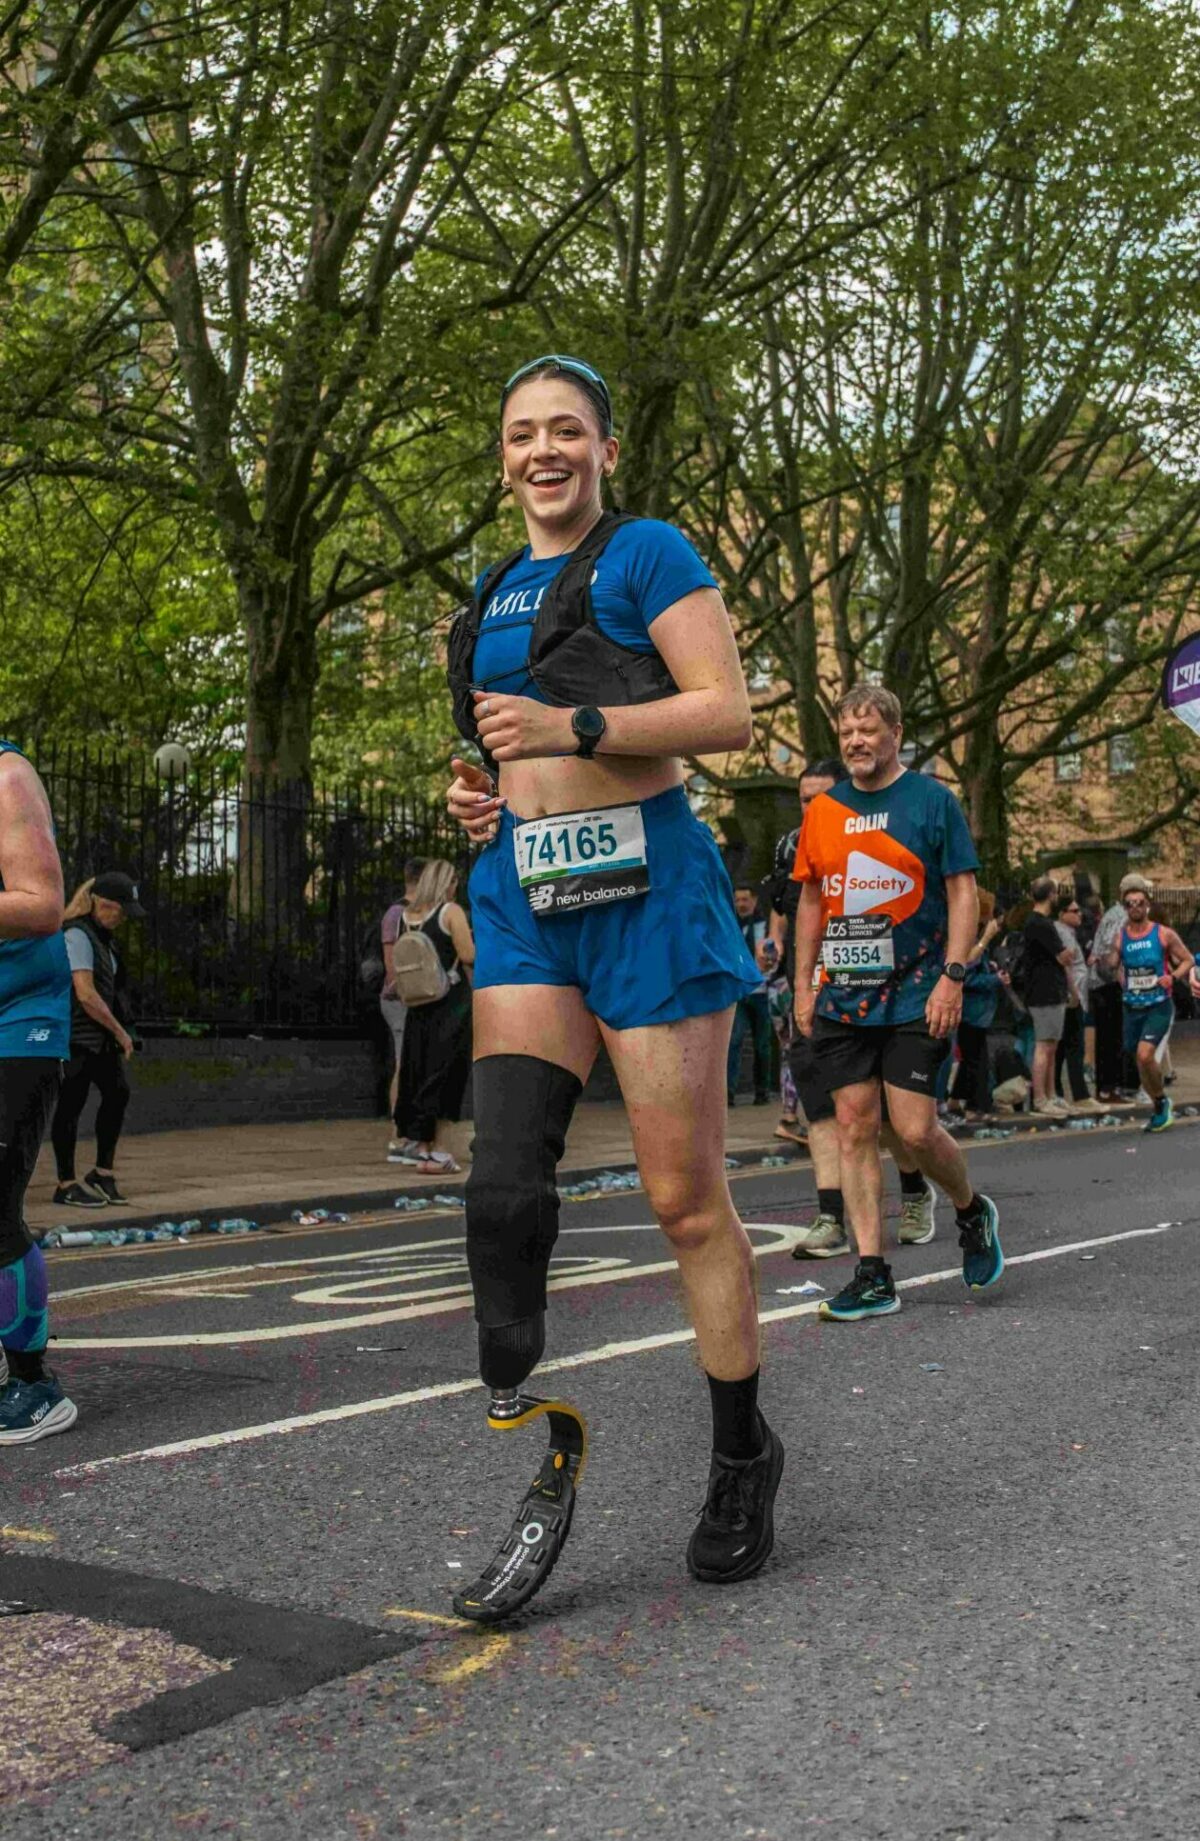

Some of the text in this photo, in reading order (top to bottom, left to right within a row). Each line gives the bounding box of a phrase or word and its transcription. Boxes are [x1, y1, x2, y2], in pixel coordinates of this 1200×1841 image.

[844, 812, 889, 834] COLIN
[525, 822, 617, 868] 74165
[848, 875, 908, 893] Society
[556, 893, 580, 906] new
[583, 885, 636, 901] balance
[833, 945, 881, 965] 53554
[1127, 940, 1151, 952] CHRIS
[30, 1401, 50, 1424] HOKA
